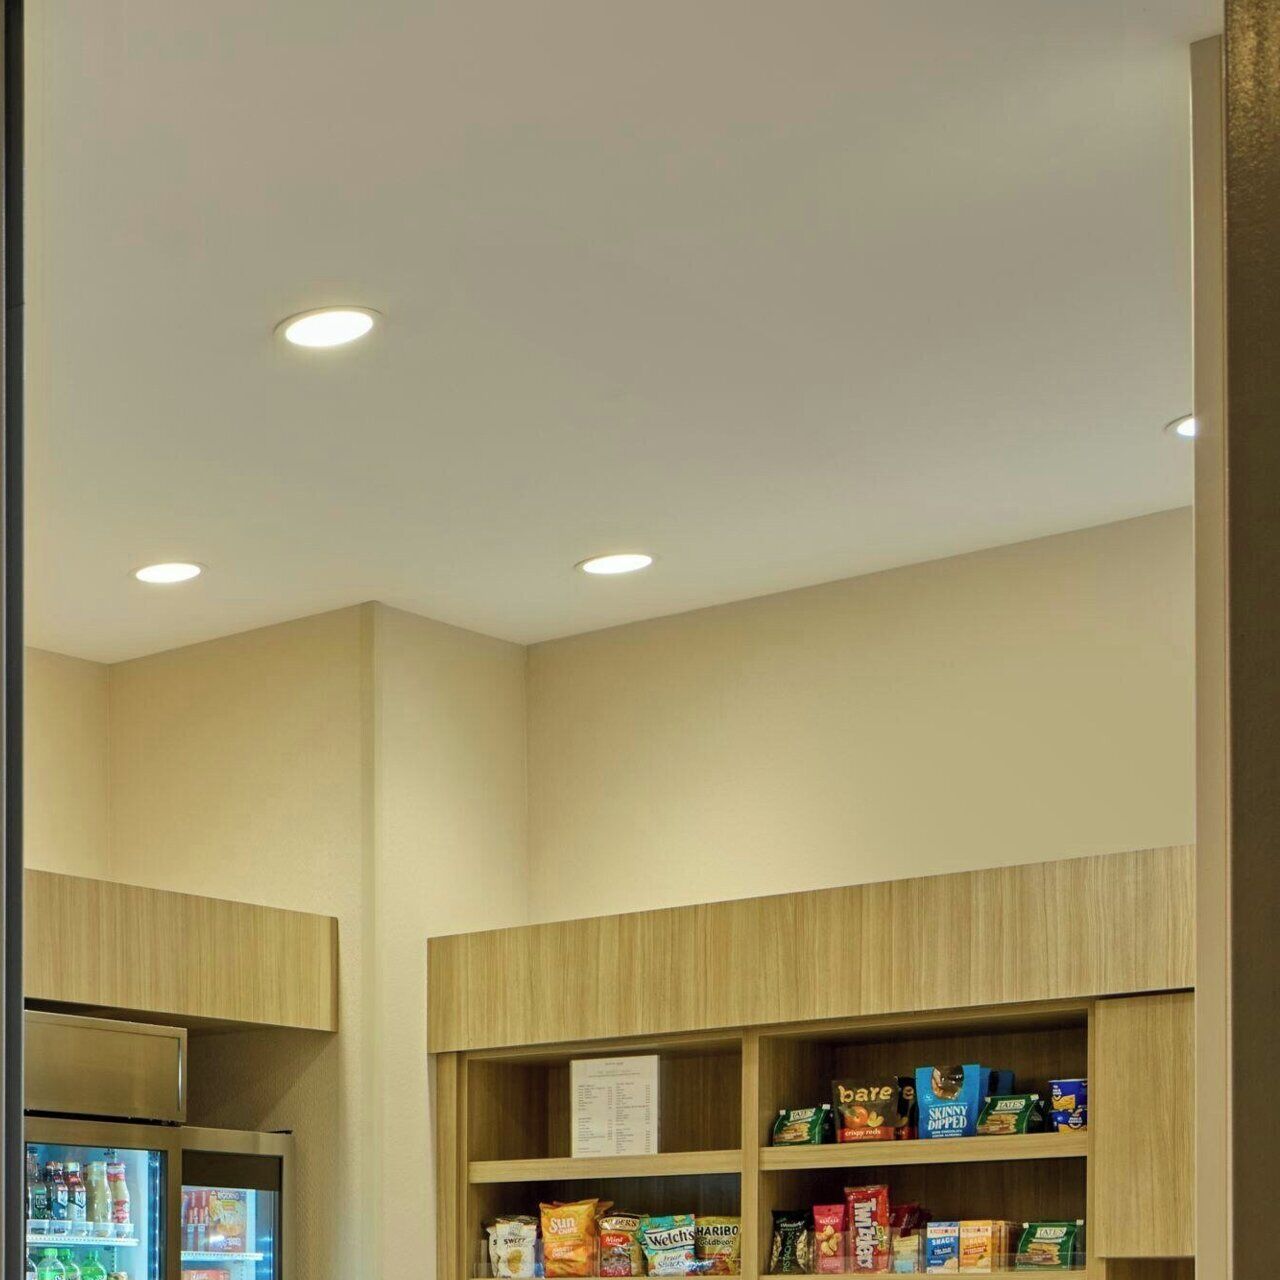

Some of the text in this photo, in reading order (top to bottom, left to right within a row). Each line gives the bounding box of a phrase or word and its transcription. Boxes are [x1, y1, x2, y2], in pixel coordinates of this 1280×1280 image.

[838, 1085, 893, 1103] bare
[929, 1105, 968, 1120] SKINNY
[928, 1115, 967, 1130] DIPPED
[845, 1128, 881, 1137] crispy reds
[550, 1217, 576, 1234] Sun
[696, 1225, 739, 1236] HARIBO
[605, 1234, 624, 1243] Mini
[648, 1228, 695, 1247] Welch's
